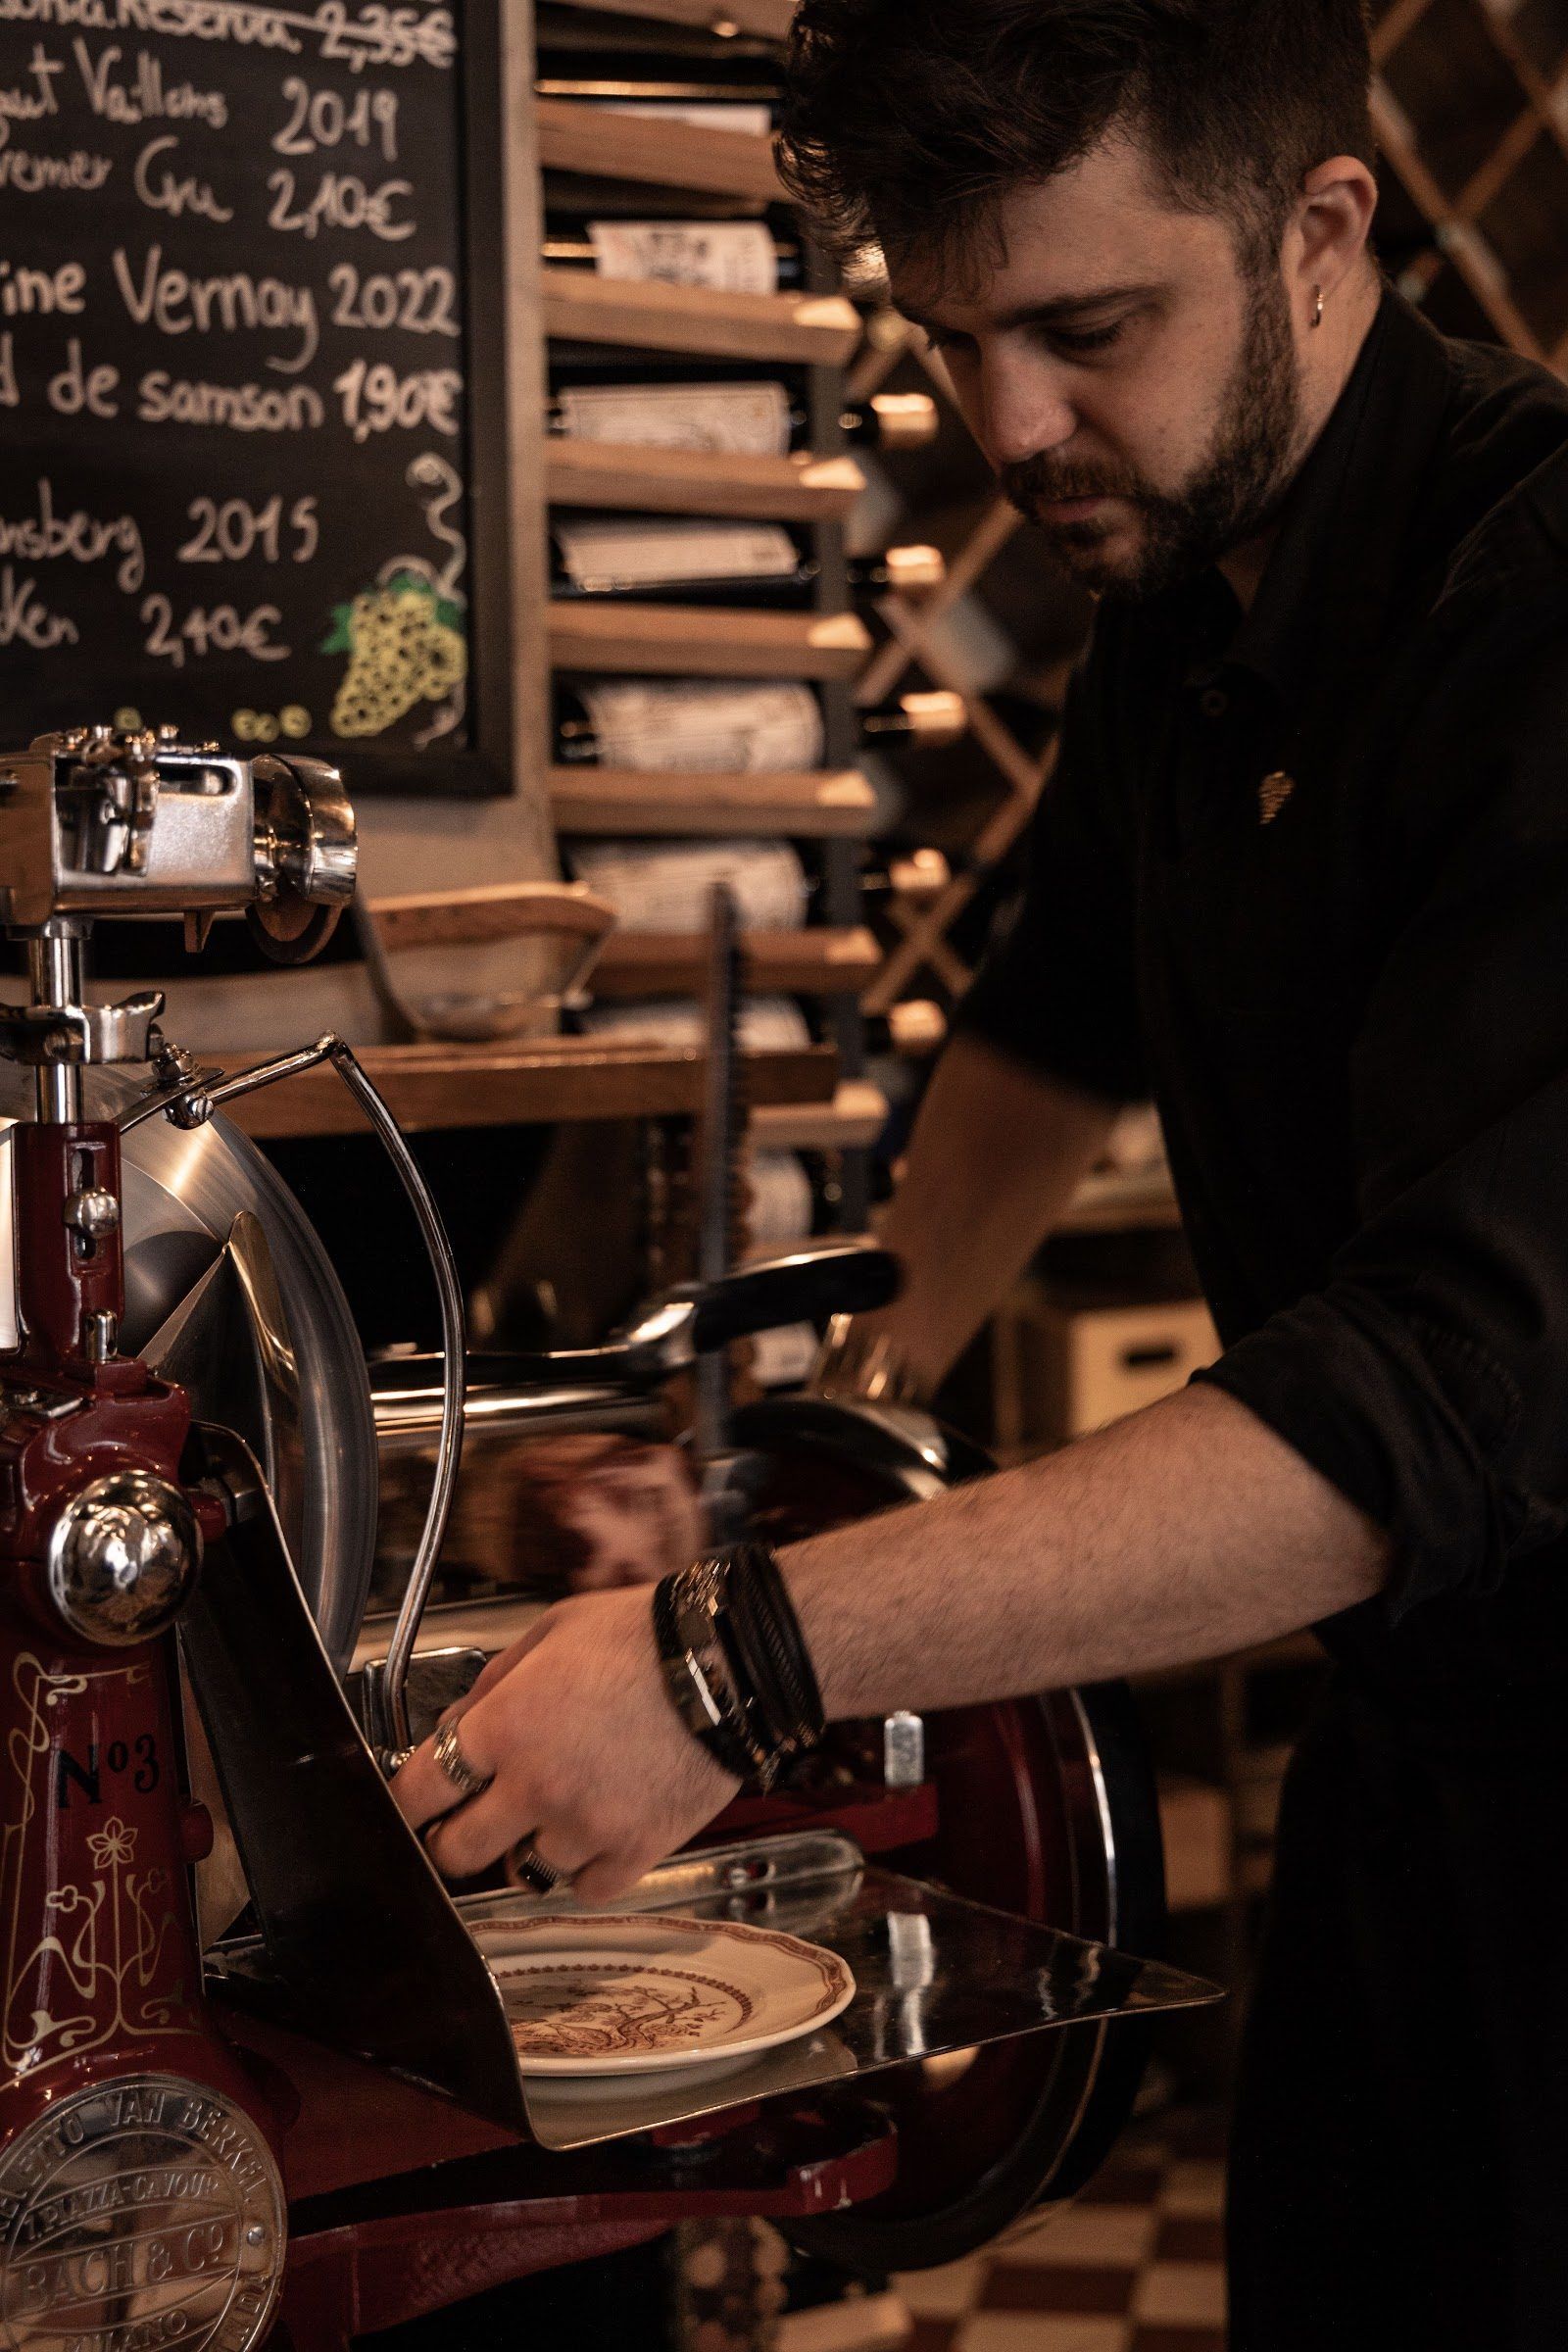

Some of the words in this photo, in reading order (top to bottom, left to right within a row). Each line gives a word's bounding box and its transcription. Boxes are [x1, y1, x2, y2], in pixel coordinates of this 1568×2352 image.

[272, 76, 398, 163] 2019
[0, 260, 86, 316] ine
[112, 245, 318, 372] Vernay
[328, 263, 462, 336] 2022
[48, 336, 120, 418] de
[177, 495, 319, 564] 2015
